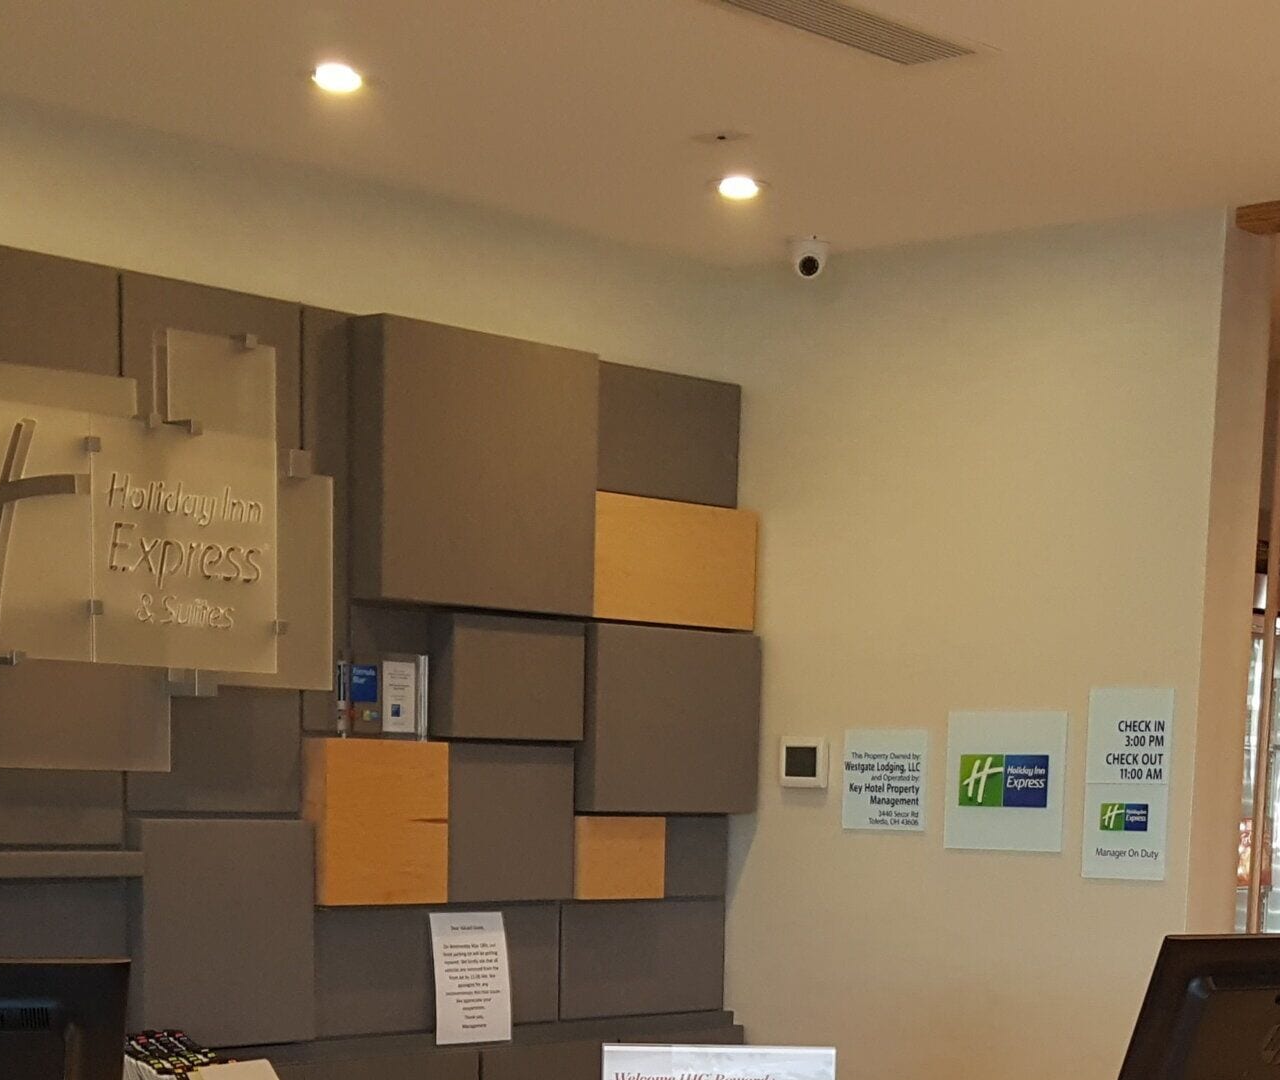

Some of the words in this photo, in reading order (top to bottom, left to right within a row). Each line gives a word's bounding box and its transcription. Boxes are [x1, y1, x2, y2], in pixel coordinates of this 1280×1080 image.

[106, 472, 216, 527] Holiday
[223, 486, 262, 523] Inn
[108, 521, 262, 589] Express
[137, 593, 153, 624] &
[160, 595, 235, 628] Suites
[1118, 720, 1152, 732] CHECK
[1154, 720, 1165, 732] IN
[1124, 735, 1146, 747] 3:00
[1148, 735, 1164, 747] PM
[864, 752, 889, 761] Property
[889, 752, 911, 760] Owned
[1106, 753, 1139, 765] CHECK
[1141, 753, 1164, 765] OUT
[844, 761, 876, 774] Westgate
[876, 762, 907, 774] Lodging,
[908, 762, 921, 772] LLC
[1006, 765, 1034, 776] Holiday
[1034, 766, 1046, 775] Inn
[882, 774, 911, 782] Operated
[1119, 768, 1143, 780] 11:00
[1145, 768, 1163, 780] AM
[848, 783, 863, 795] Key
[864, 783, 885, 793] Hotel
[886, 783, 920, 795] Property
[1006, 775, 1046, 791] Express
[869, 795, 919, 808] Management
[1095, 847, 1127, 859] Manager
[1128, 848, 1139, 858] On
[1140, 849, 1159, 860] Duty
